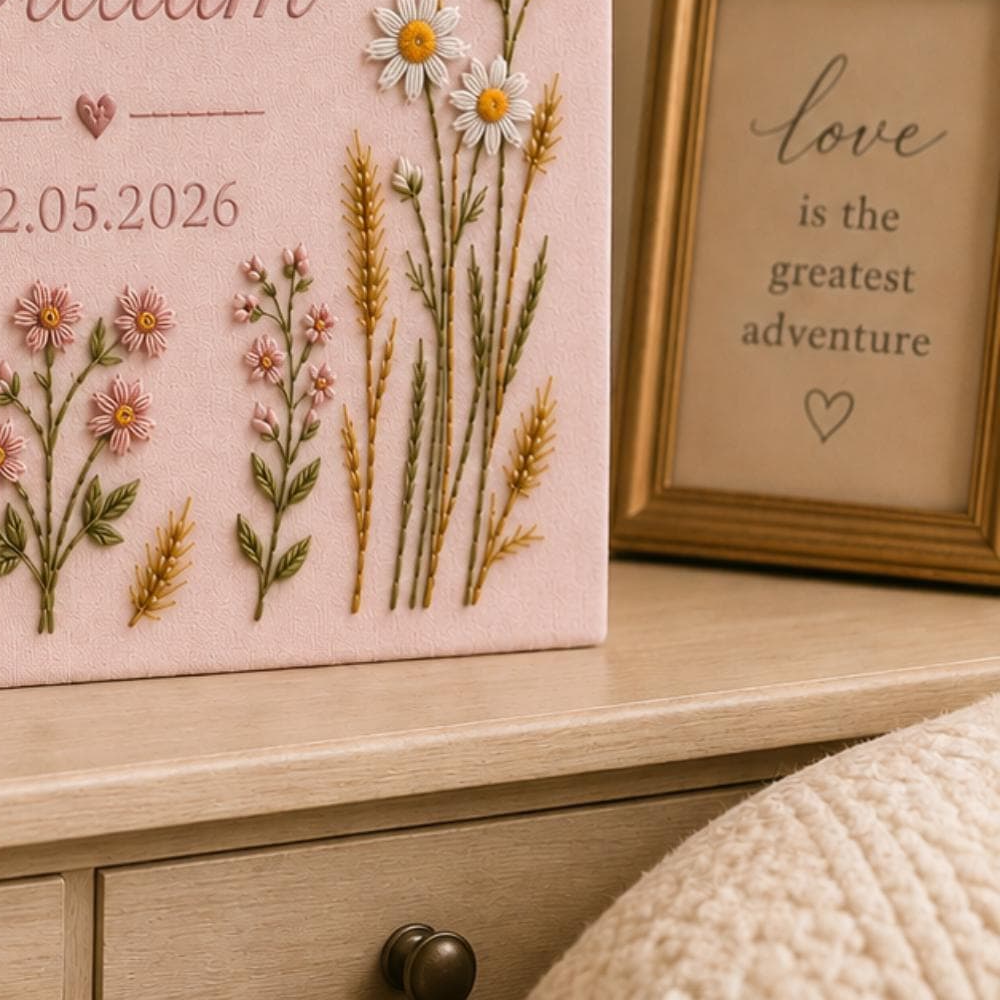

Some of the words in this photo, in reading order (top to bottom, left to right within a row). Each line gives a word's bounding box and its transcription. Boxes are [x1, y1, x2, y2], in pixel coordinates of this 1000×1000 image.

[750, 53, 947, 165] love
[798, 193, 826, 228] is
[842, 195, 900, 232] the
[767, 259, 915, 295] greatest
[741, 311, 931, 357] adventure
